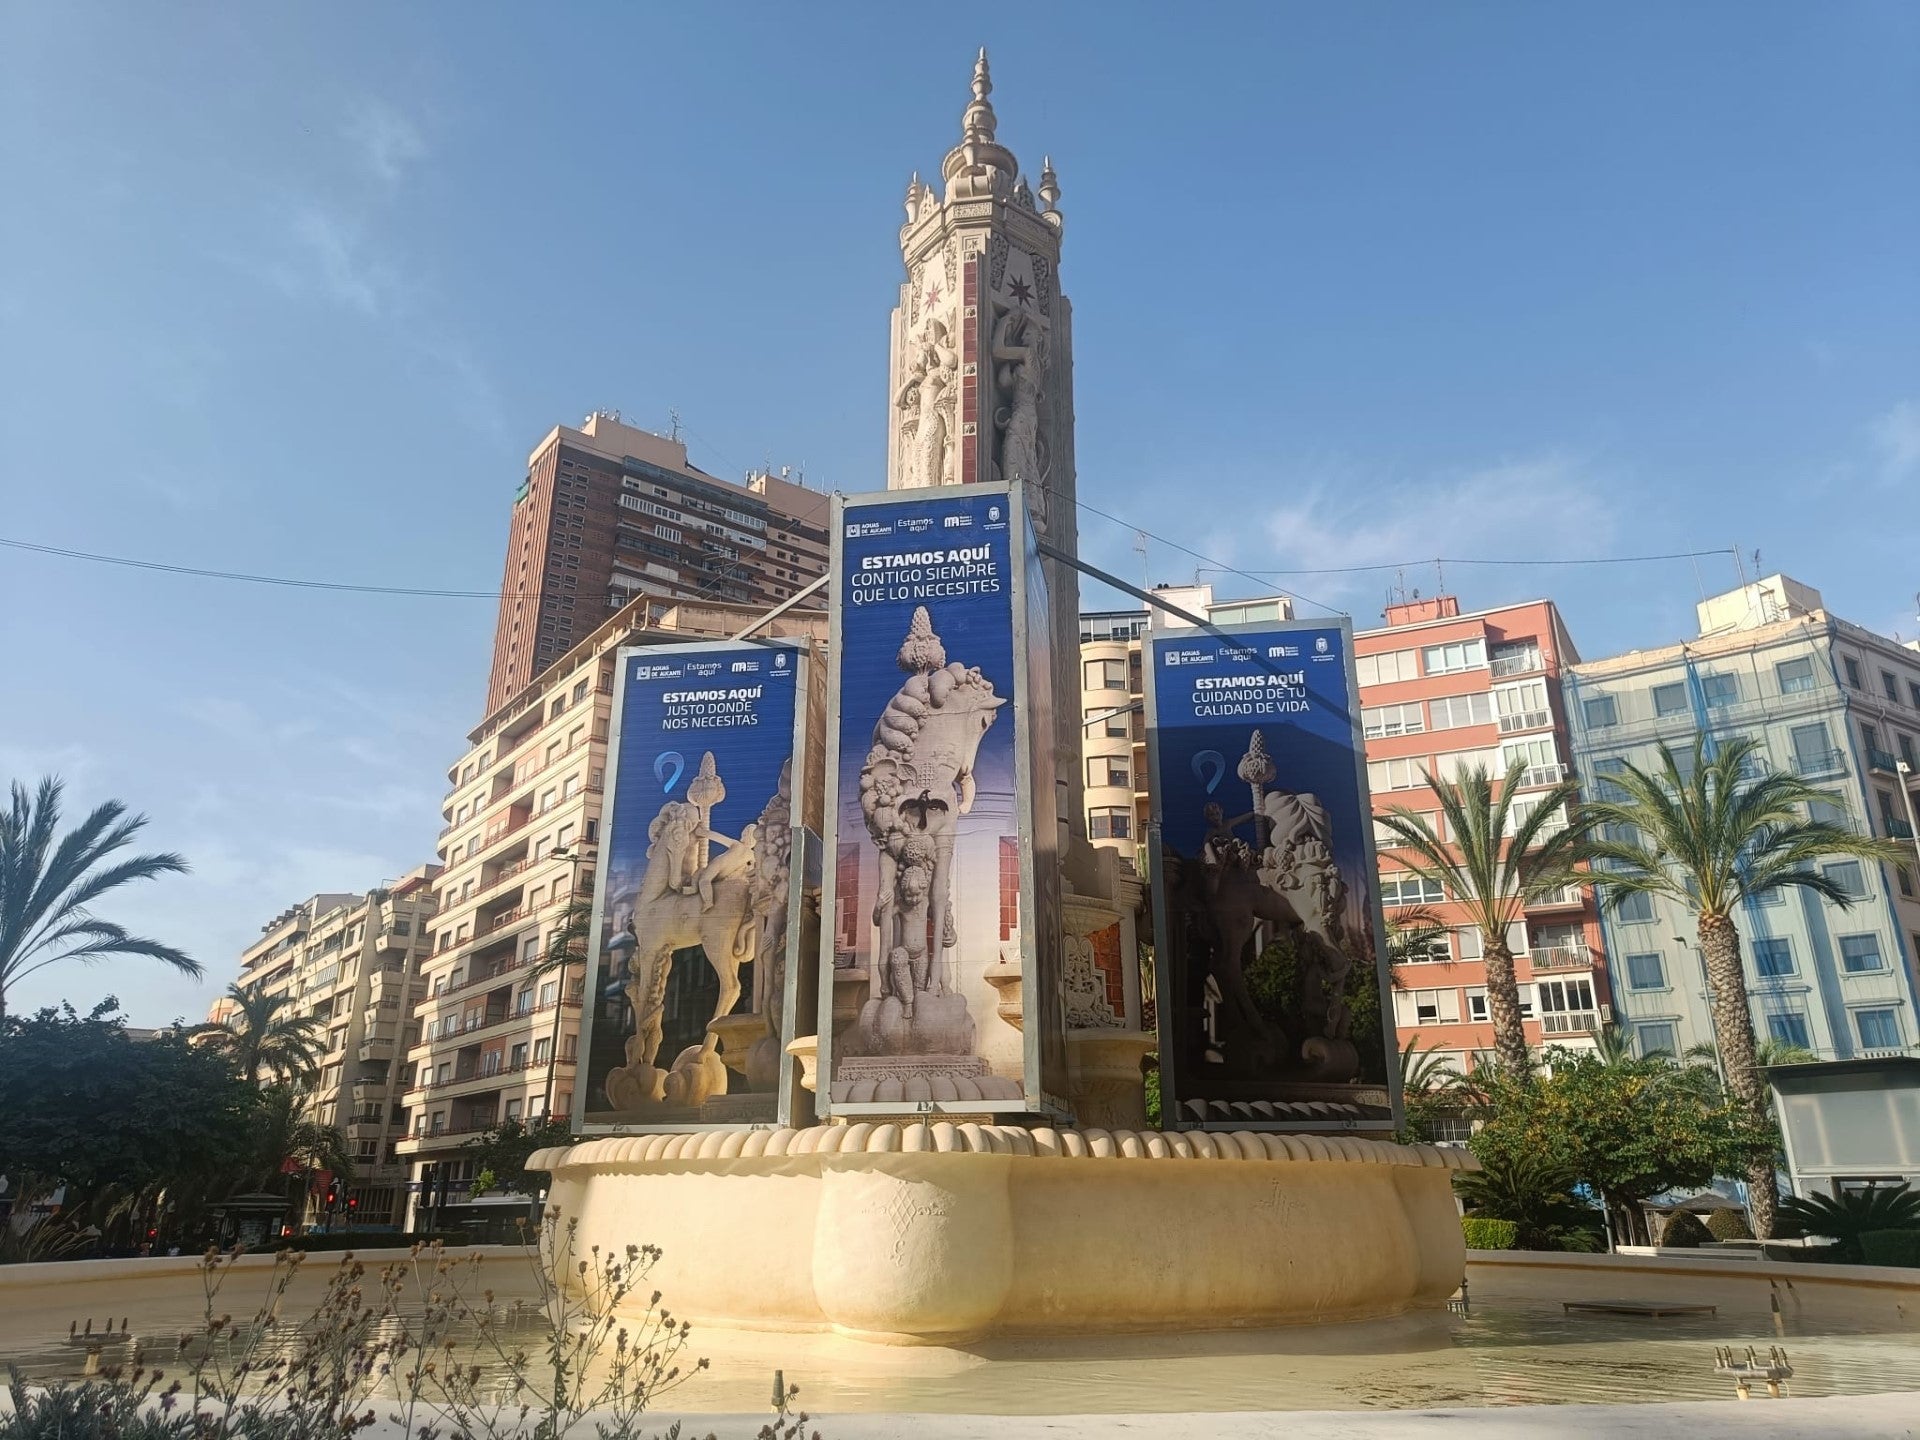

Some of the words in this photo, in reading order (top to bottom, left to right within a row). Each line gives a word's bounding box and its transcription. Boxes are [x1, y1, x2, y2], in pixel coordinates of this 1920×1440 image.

[898, 518, 934, 527] Estamos
[862, 552, 944, 570] ESTAMOS
[947, 543, 991, 564] AQUÍ
[852, 570, 922, 587] CONTIGO
[926, 562, 997, 581] SIEMPRE
[852, 588, 885, 606] QUE
[890, 586, 909, 600] LO
[914, 578, 1000, 598] NECESITES
[1219, 648, 1258, 656] Estamos
[687, 662, 722, 670] Estamos
[1196, 675, 1265, 690] ESTAMOS
[1268, 670, 1304, 688] AQUÍ
[662, 689, 726, 703] ESTAMOS
[728, 685, 763, 702] AQUÍ
[1192, 689, 1263, 704] CUIDANDO
[1266, 688, 1284, 699] DE
[1286, 687, 1306, 698] TU
[667, 704, 704, 716] JUSTO
[708, 702, 752, 714] DONDE
[1194, 703, 1254, 717] CALIDAD
[1256, 702, 1274, 714] DE
[1277, 700, 1310, 712] VIDA
[662, 718, 688, 730] NOS
[692, 714, 758, 728] NECESITAS
